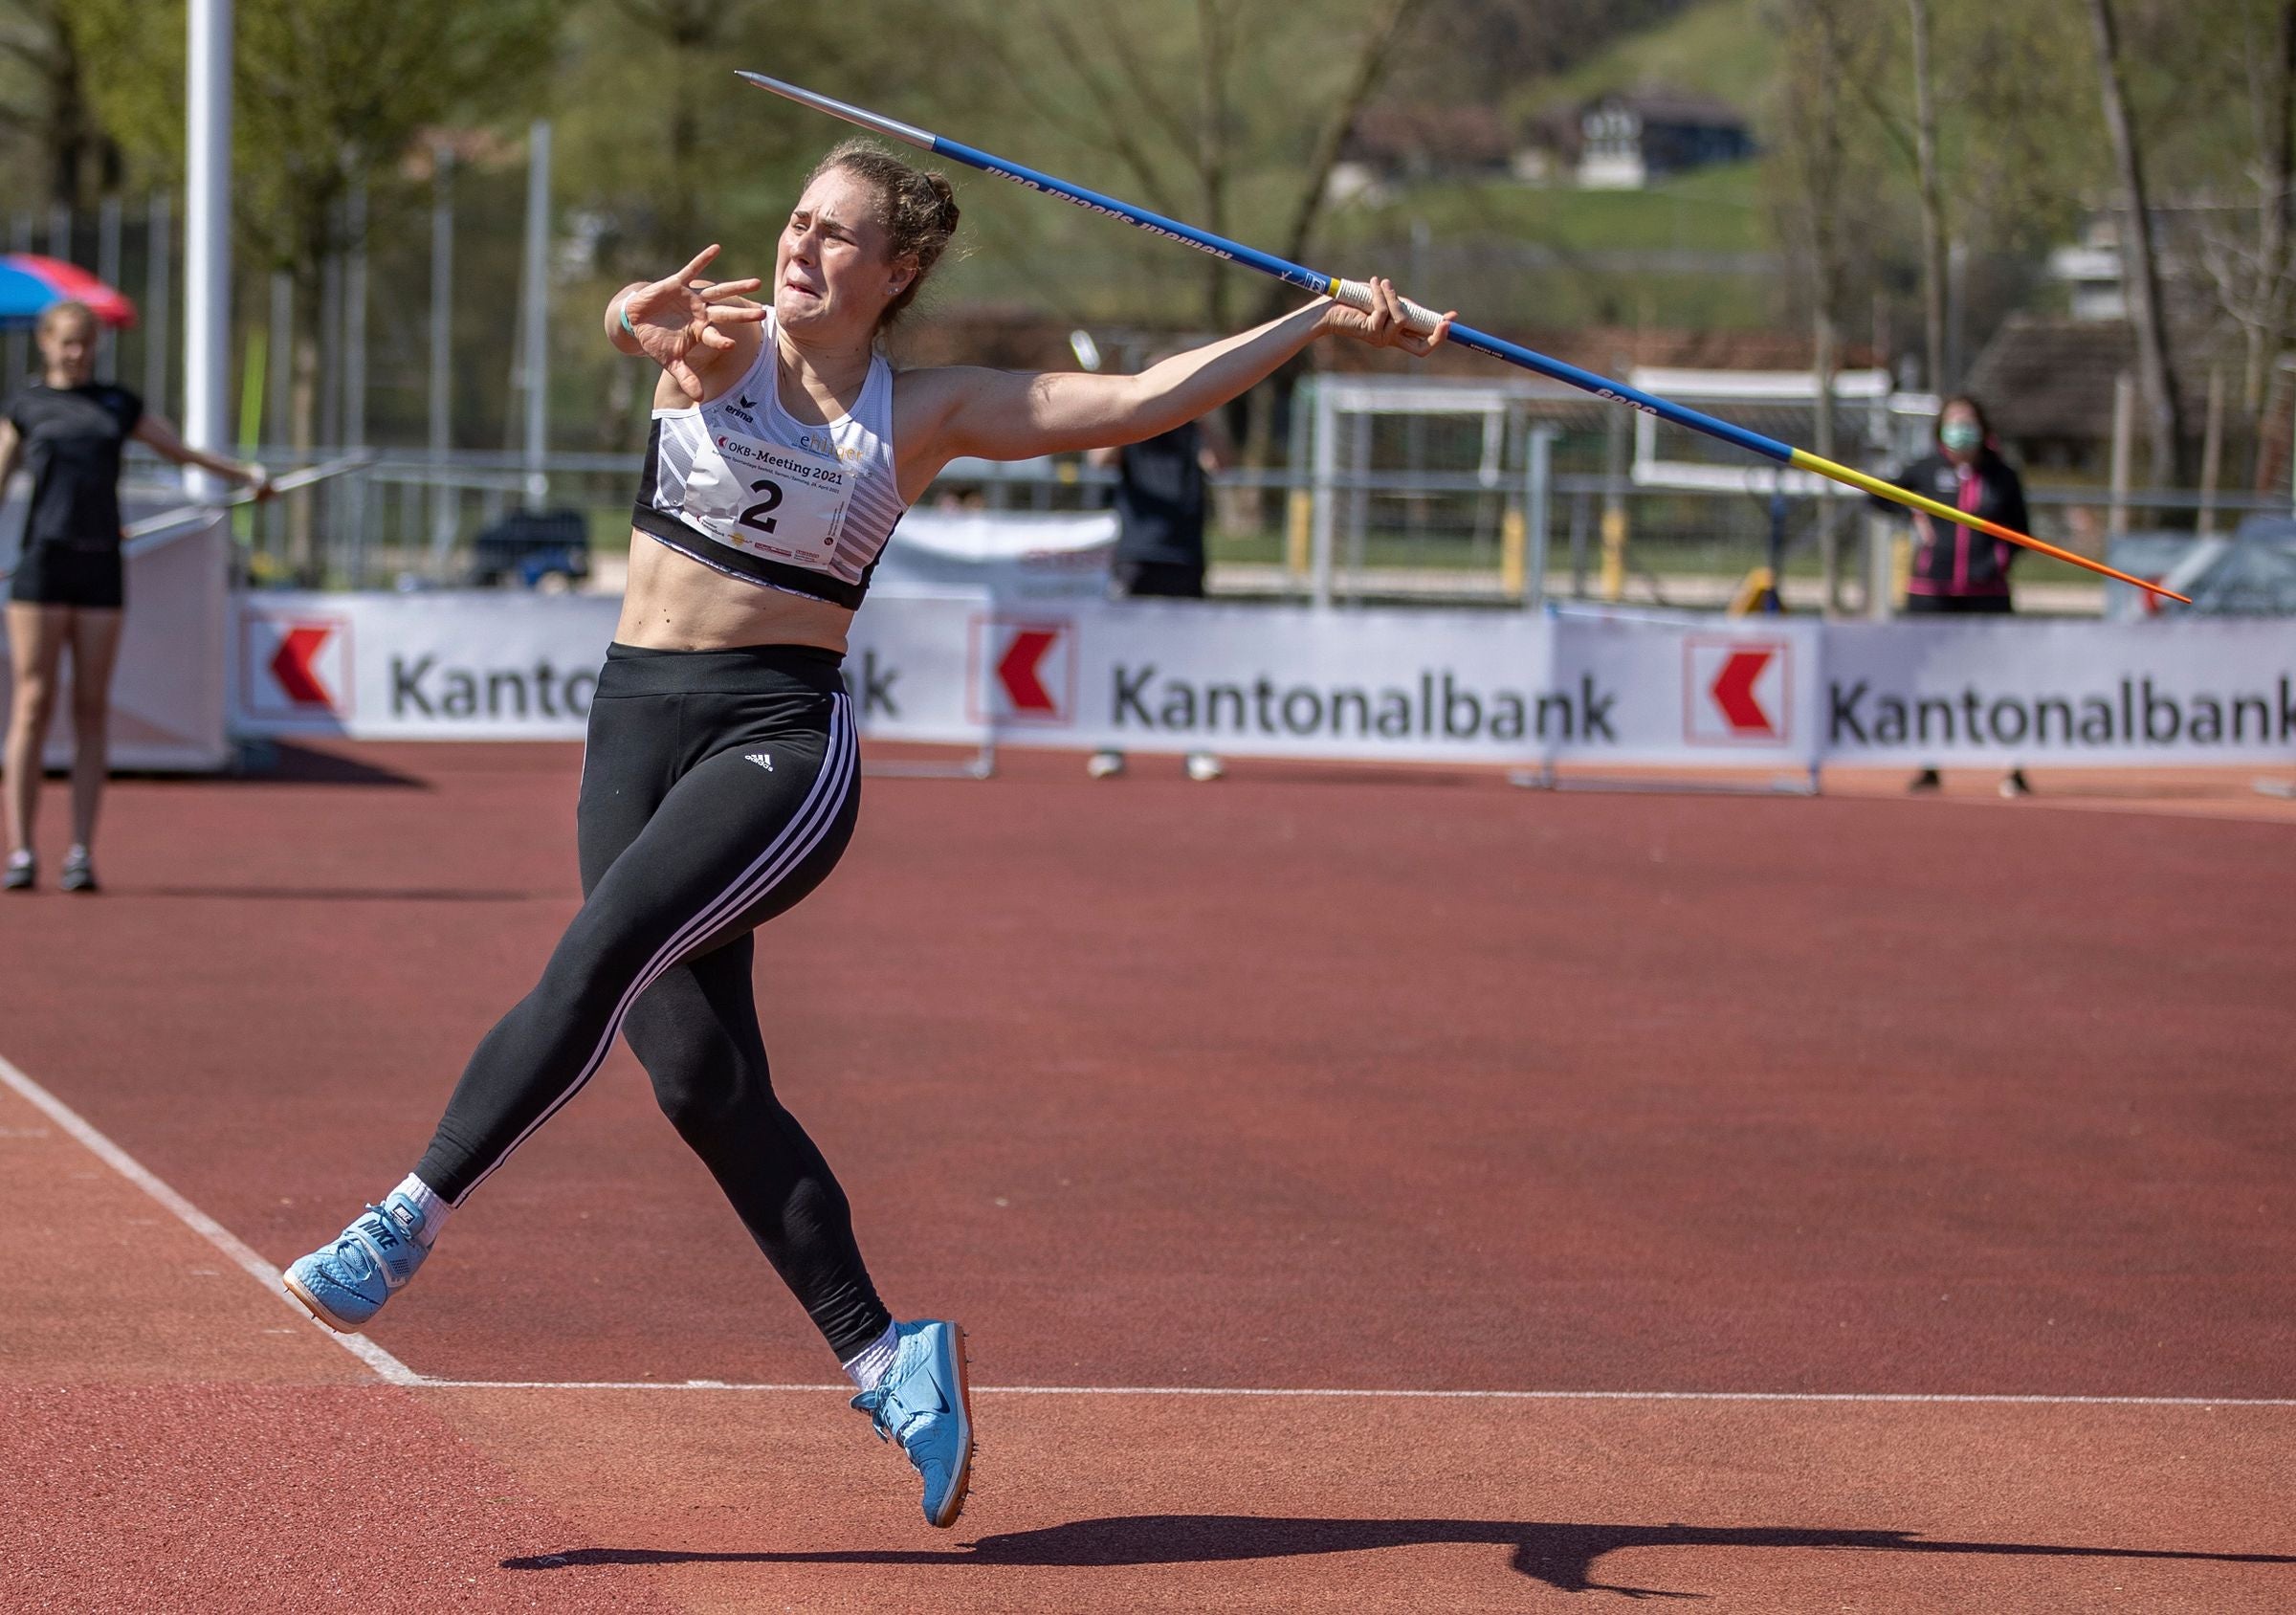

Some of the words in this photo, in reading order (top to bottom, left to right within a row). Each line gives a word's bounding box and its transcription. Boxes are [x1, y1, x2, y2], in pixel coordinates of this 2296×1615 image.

[725, 405, 754, 423] erima
[728, 442, 811, 477] OKB-Meeting
[812, 467, 843, 485] 2021
[739, 479, 784, 534] 2
[1110, 666, 1618, 743] Kantonalbank
[745, 755, 773, 772] adidas
[393, 1206, 414, 1223] NIKE
[358, 1218, 400, 1251] NIKE
